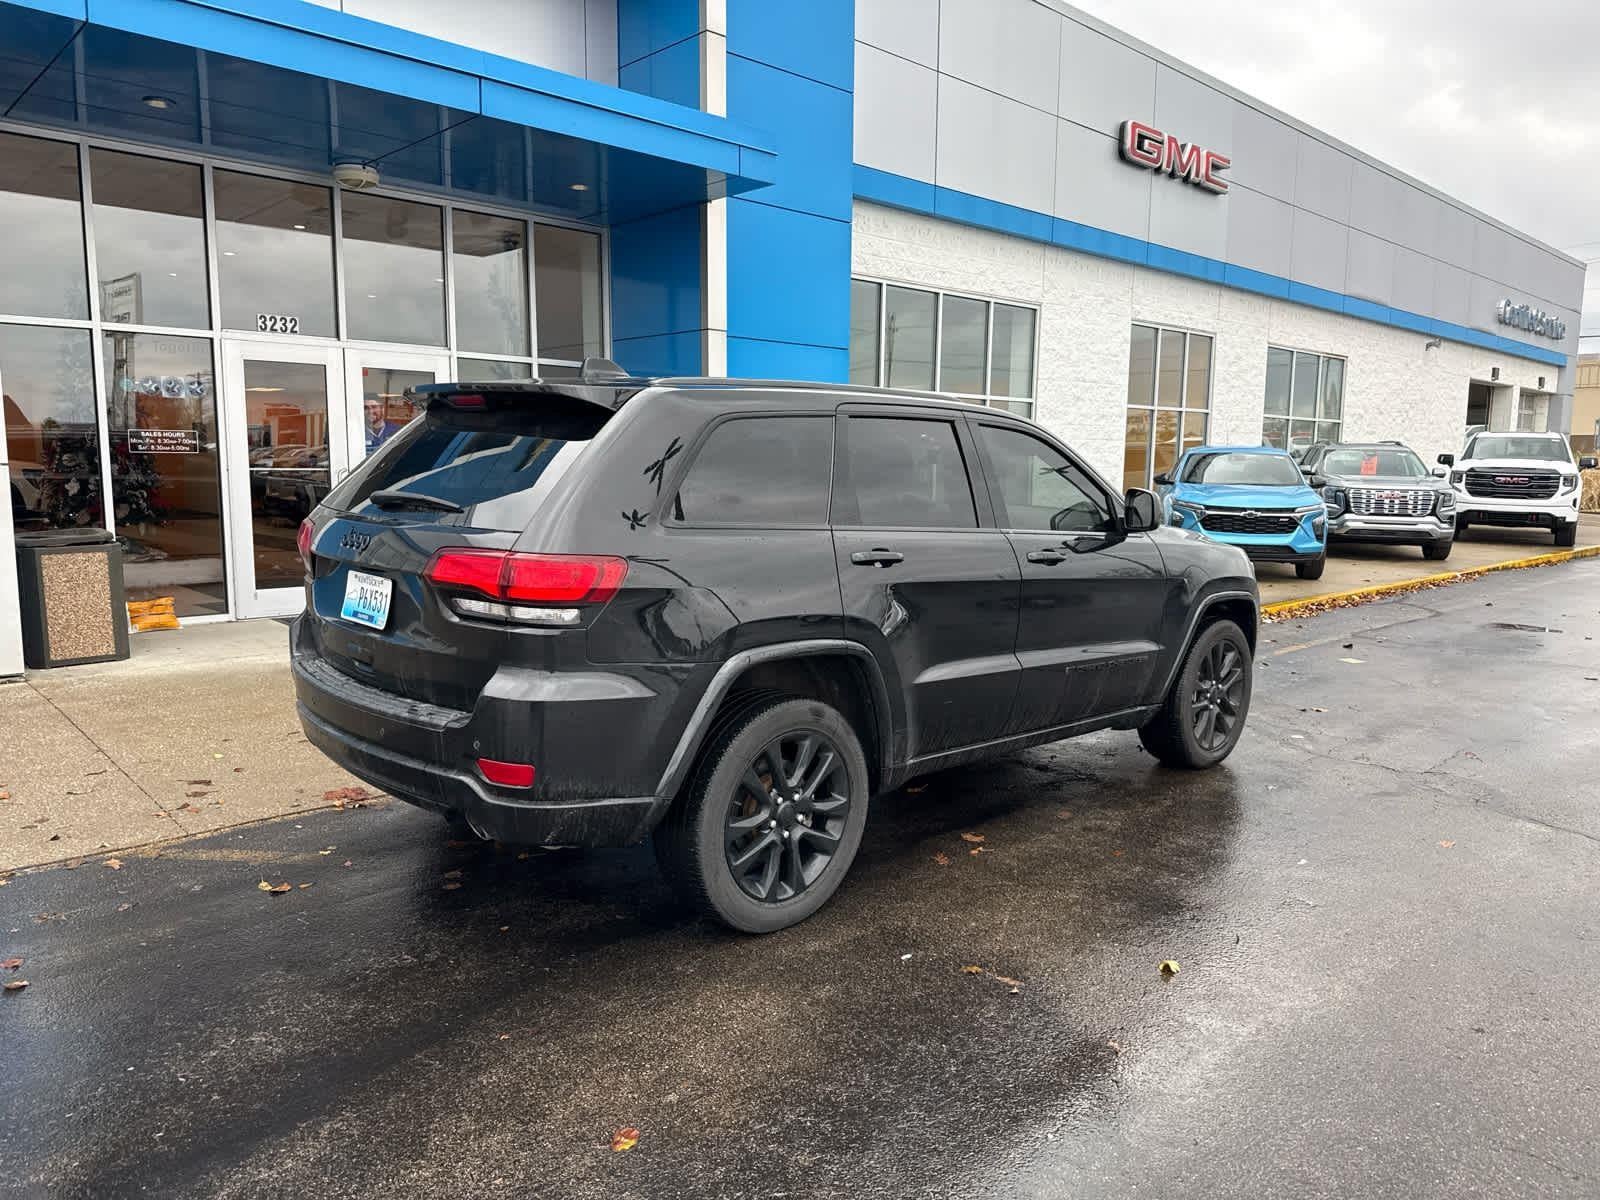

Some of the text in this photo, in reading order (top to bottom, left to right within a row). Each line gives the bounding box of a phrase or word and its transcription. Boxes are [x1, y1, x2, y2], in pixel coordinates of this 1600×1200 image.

[1119, 119, 1232, 195] GMC
[258, 314, 299, 333] 3232
[1495, 476, 1529, 485] GMC
[341, 528, 371, 553] Jeep
